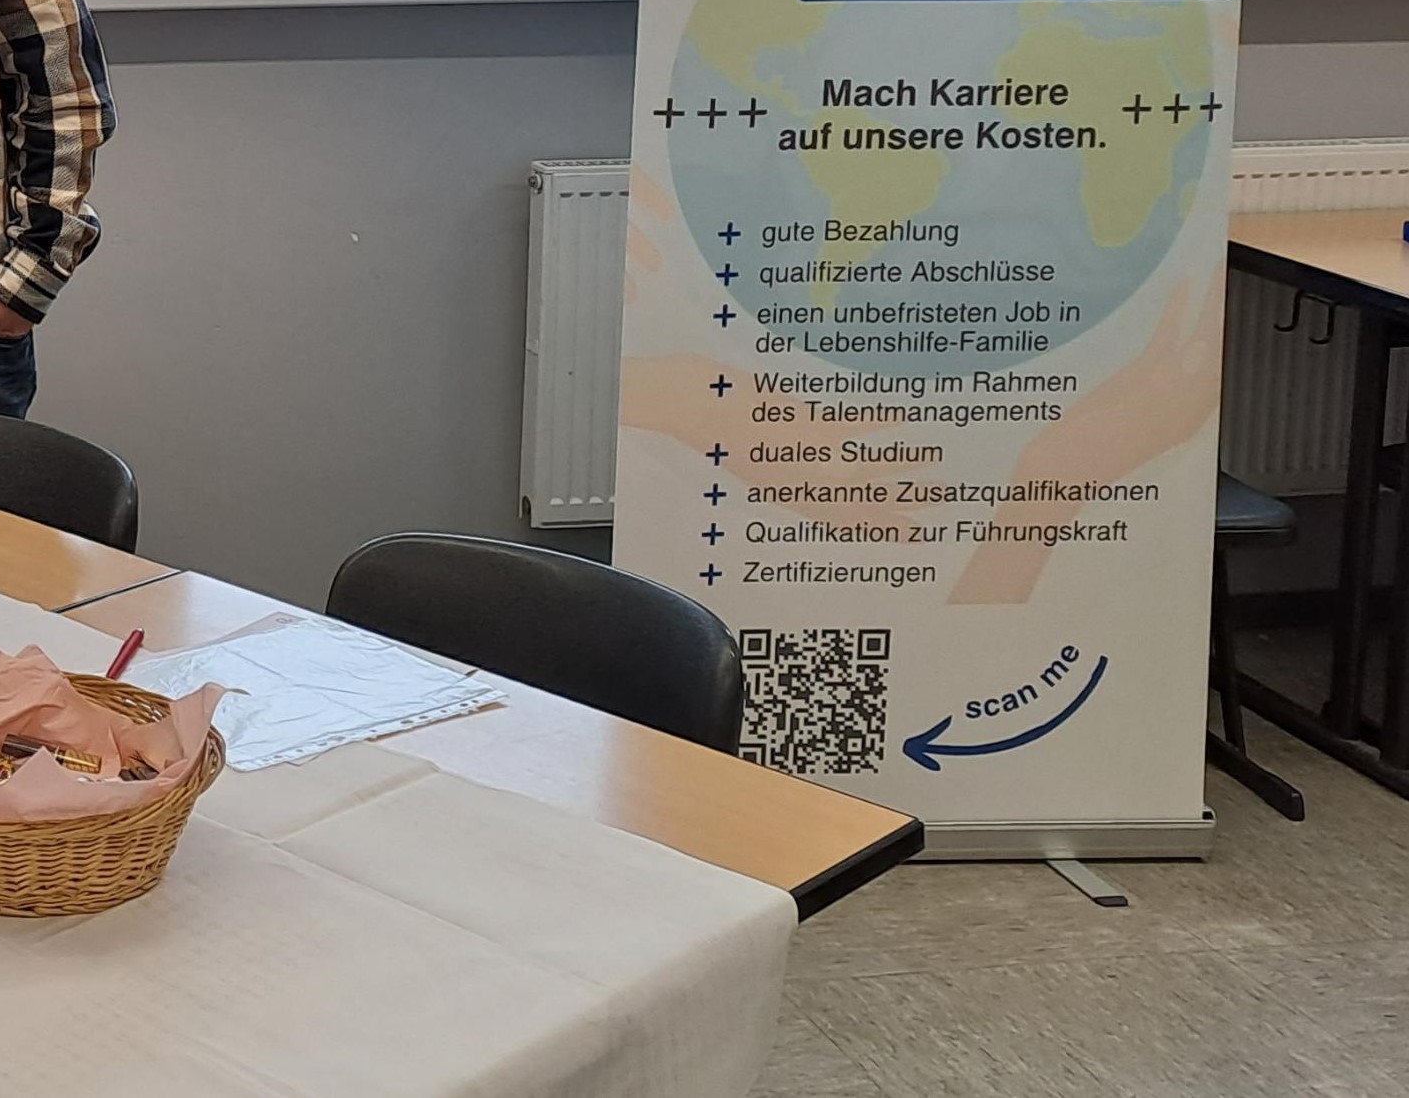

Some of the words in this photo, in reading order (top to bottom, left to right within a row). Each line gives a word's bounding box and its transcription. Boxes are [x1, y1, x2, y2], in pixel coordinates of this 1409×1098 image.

[823, 80, 915, 106] Mach
[931, 79, 1068, 106] Karriere
[779, 123, 832, 150] auf
[844, 129, 963, 149] unsere
[977, 122, 1105, 148] Kosten.
[763, 222, 814, 248] gute
[825, 220, 958, 246] Bezahlung
[760, 261, 901, 288] qualifizierte
[911, 261, 1054, 282] Abschlüsse
[758, 303, 823, 324] einen
[835, 302, 996, 323] unbefristeten
[1006, 301, 1049, 322] Job
[1060, 301, 1079, 321] in
[756, 332, 795, 353] der
[805, 331, 1048, 352] Lebenshilfe-Familie
[754, 372, 925, 398] Weiterbildung
[935, 372, 962, 392] im
[973, 371, 1076, 392] Rahmen
[752, 402, 795, 422] des
[805, 401, 1061, 427] Talentmanagements
[750, 442, 831, 462] duales
[841, 441, 942, 462] Studium
[748, 482, 887, 502] anerkannte
[896, 480, 1158, 506] Zusatzqualifikationen
[746, 522, 898, 543] Qualifikation
[908, 527, 947, 542] zur
[957, 520, 1127, 546] Führungskraft
[743, 562, 935, 587] Zertifizierungen
[966, 685, 1038, 718] scan
[1040, 646, 1079, 687] me
